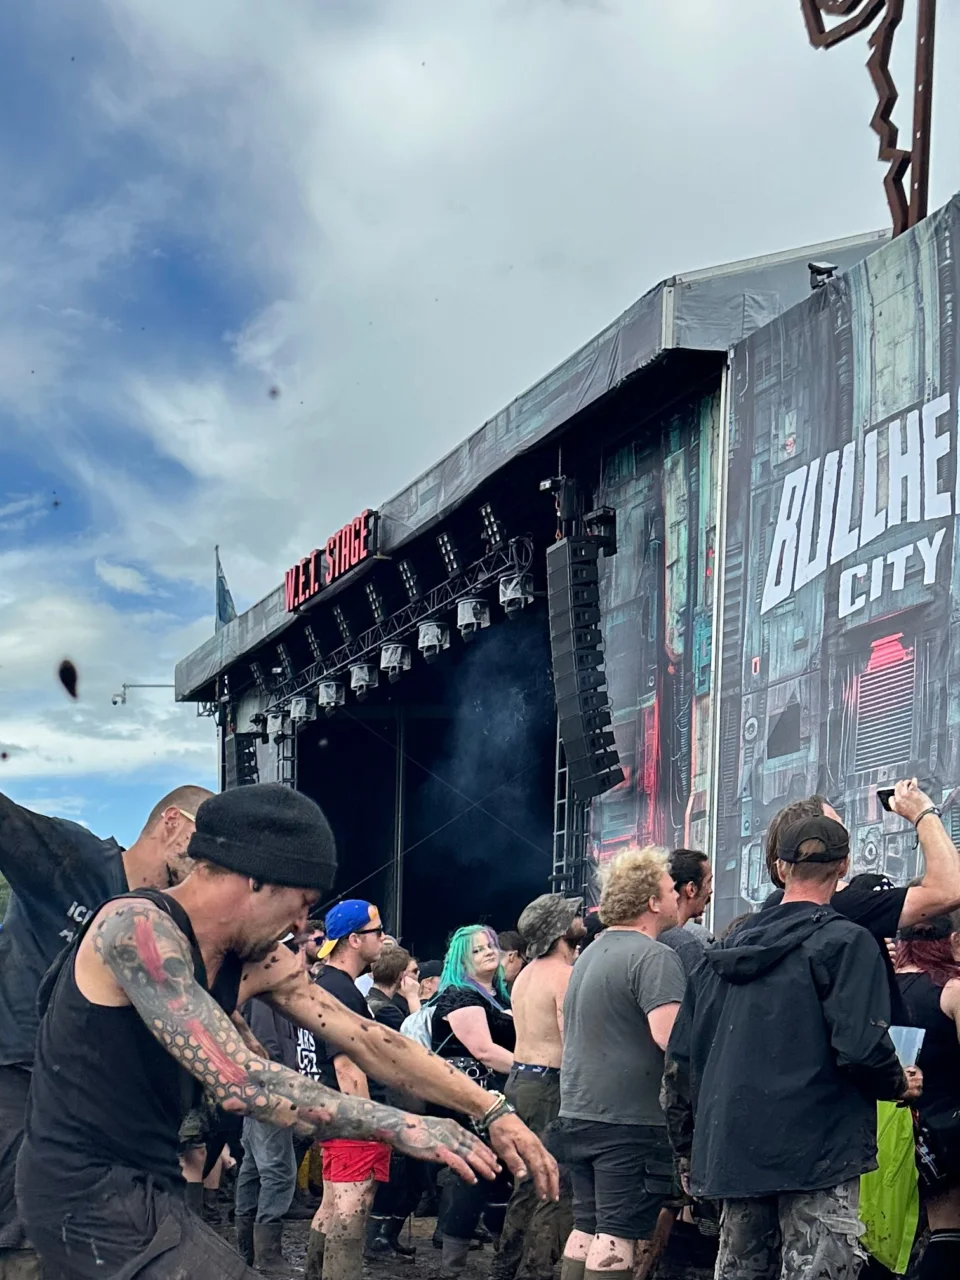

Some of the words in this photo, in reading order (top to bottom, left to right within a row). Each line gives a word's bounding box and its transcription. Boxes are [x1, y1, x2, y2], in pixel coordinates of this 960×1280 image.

[325, 508, 369, 584] STAGE
[760, 384, 960, 616] BULLHE
[838, 527, 947, 619] CITY
